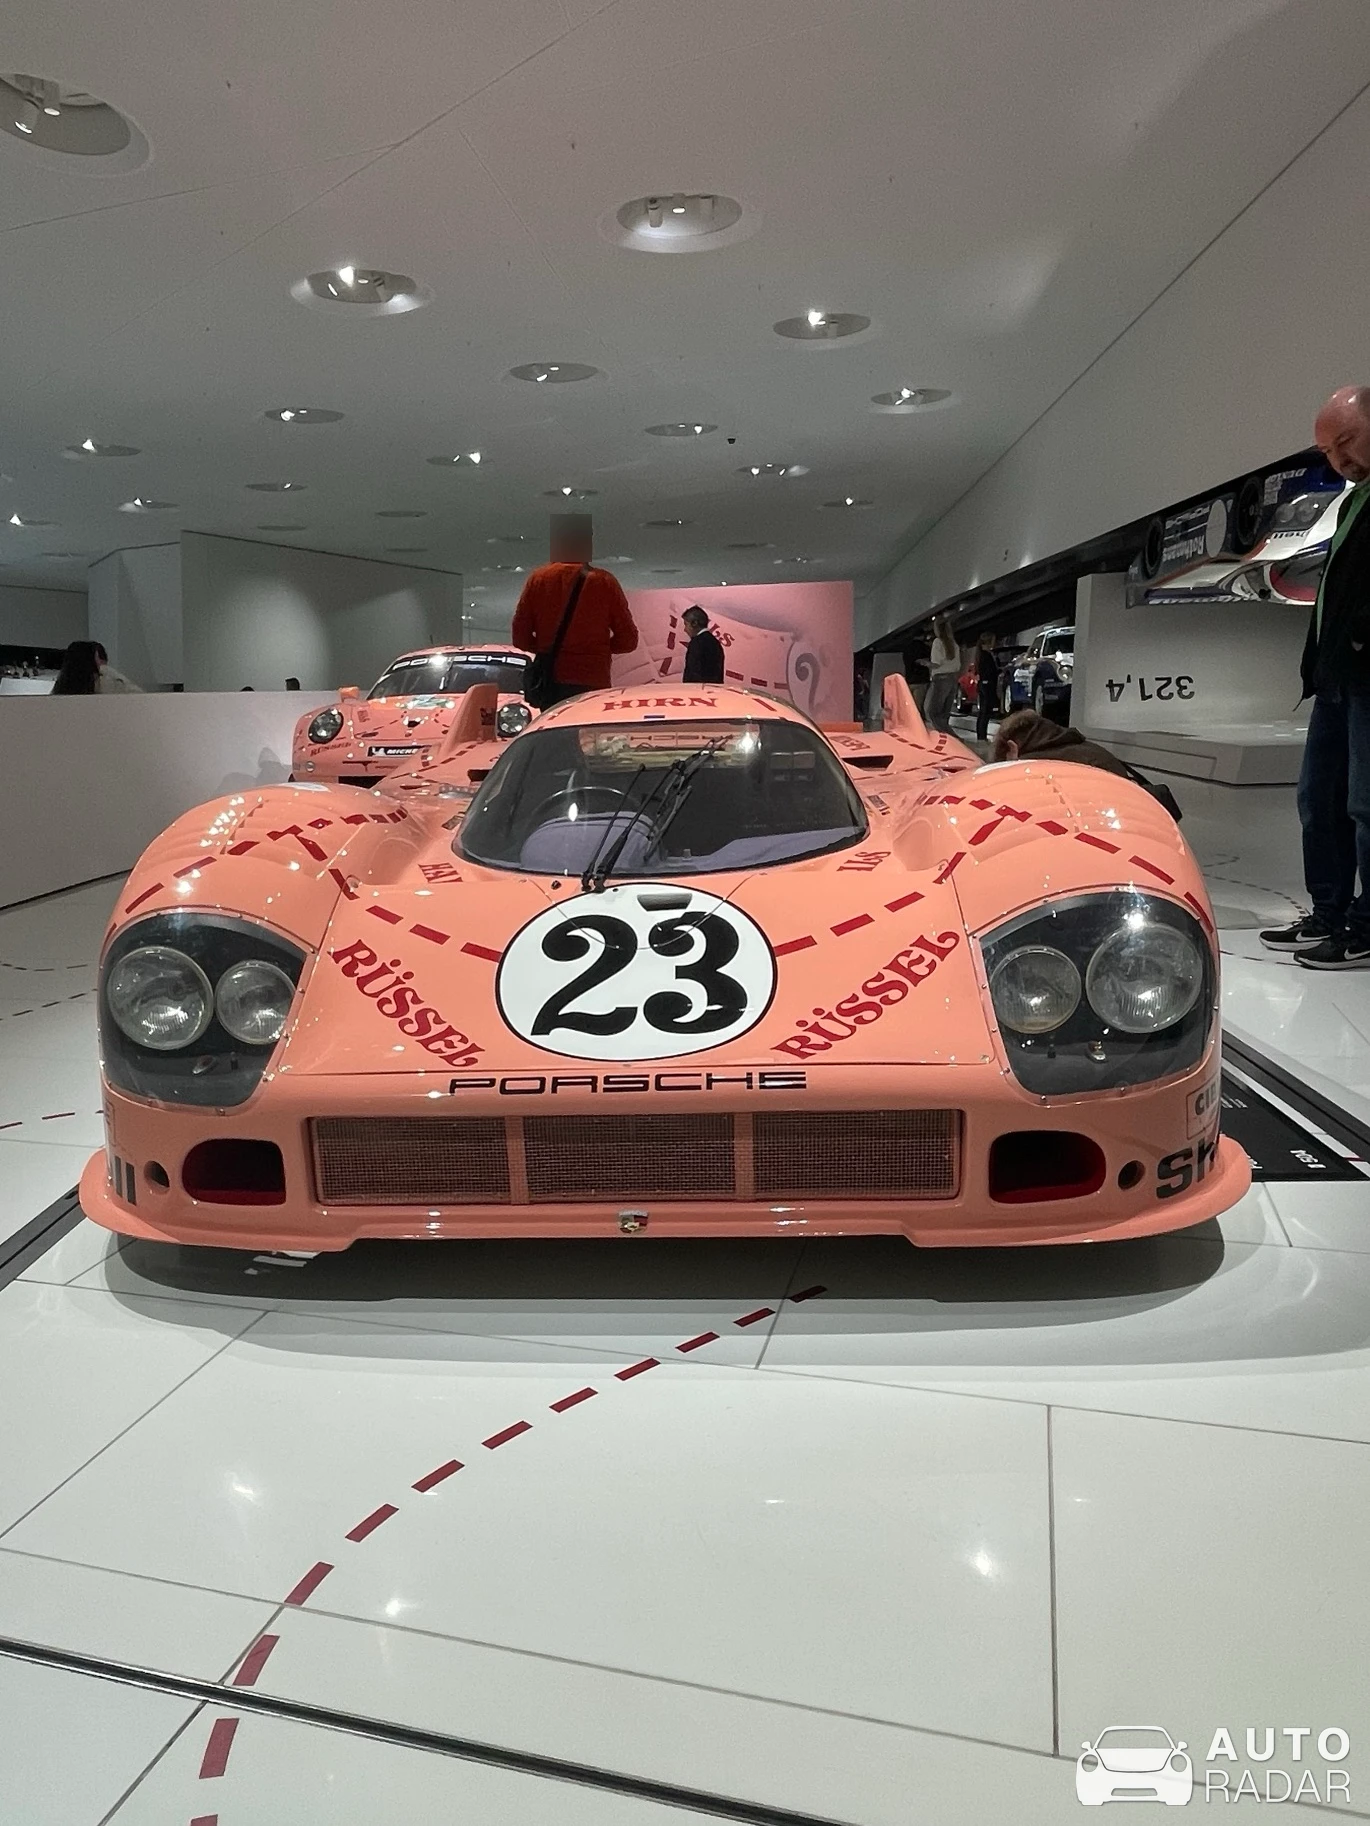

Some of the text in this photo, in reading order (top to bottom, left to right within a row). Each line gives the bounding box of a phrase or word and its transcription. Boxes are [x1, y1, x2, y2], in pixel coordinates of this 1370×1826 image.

[602, 697, 717, 711] HIRN
[1106, 674, 1195, 702] 321,4
[328, 938, 486, 1067] RÜSSEL
[531, 911, 748, 1036] 23
[770, 931, 960, 1060] RÜSSEL
[449, 1071, 807, 1096] PORSCHE
